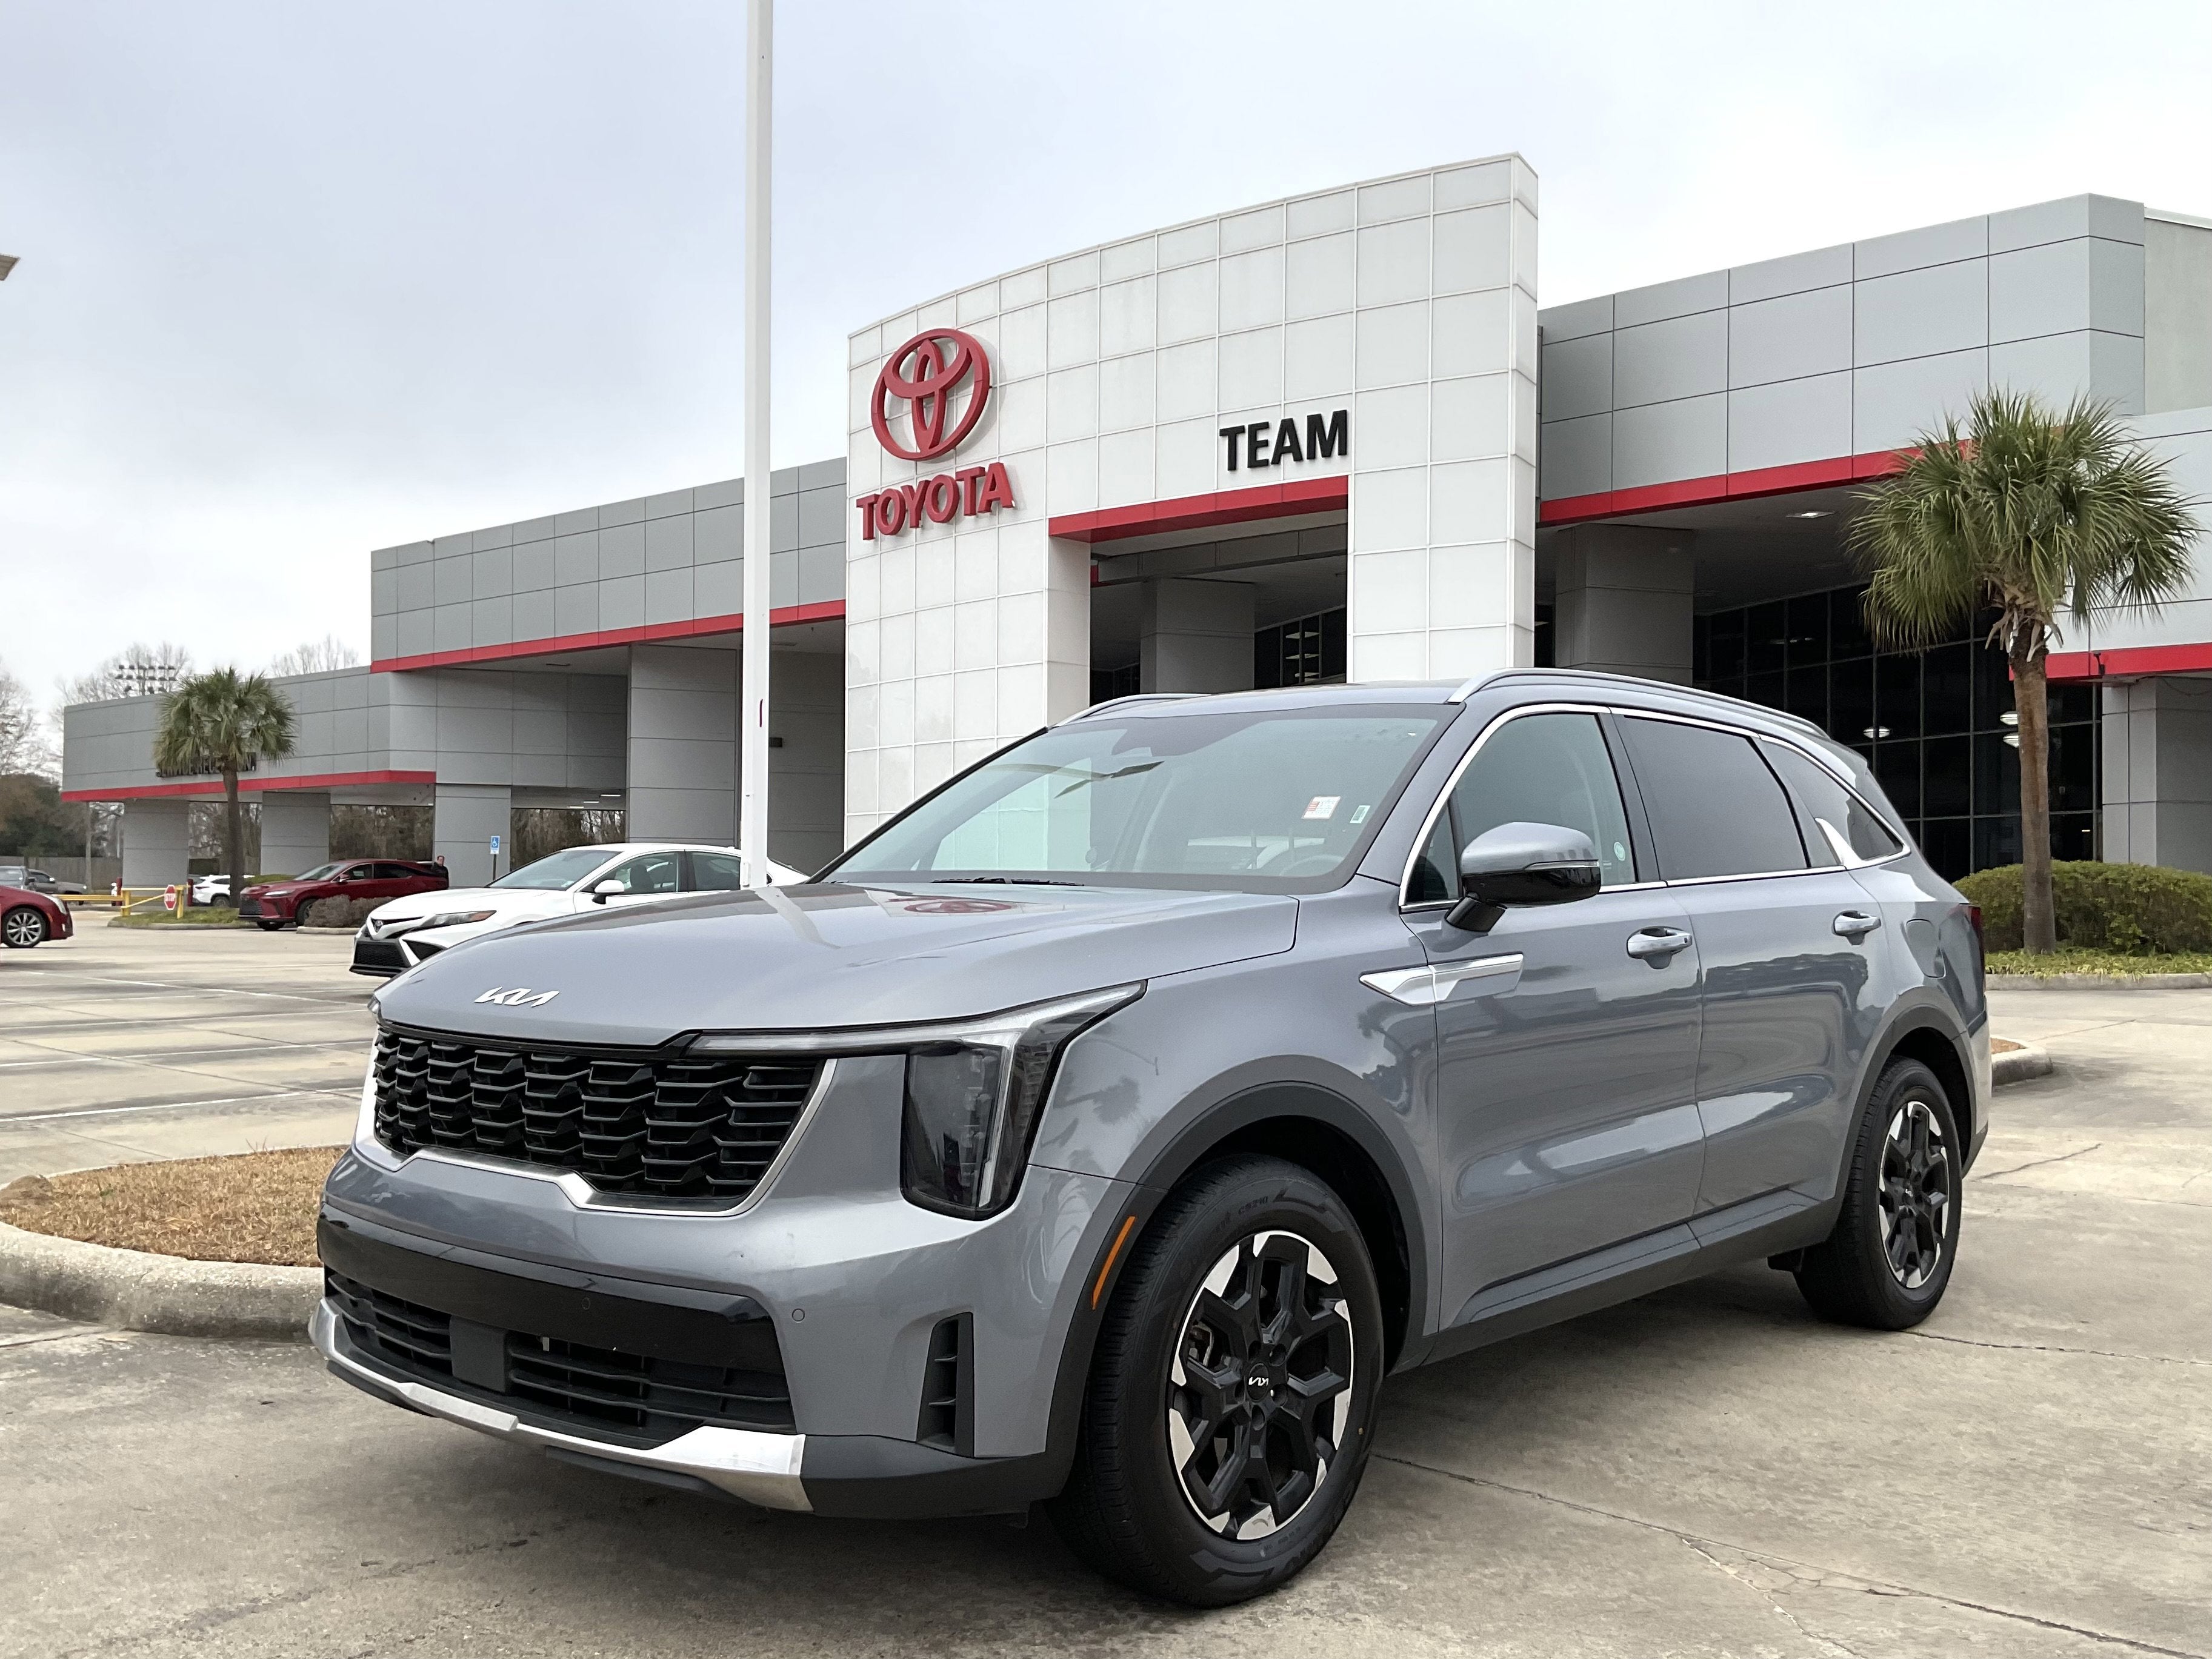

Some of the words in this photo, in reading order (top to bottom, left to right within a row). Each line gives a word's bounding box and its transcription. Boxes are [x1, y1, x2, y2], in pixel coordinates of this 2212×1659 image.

[1219, 409, 1347, 471] TEAM
[856, 462, 1015, 540] TOYOTA
[474, 986, 559, 1008] KIA
